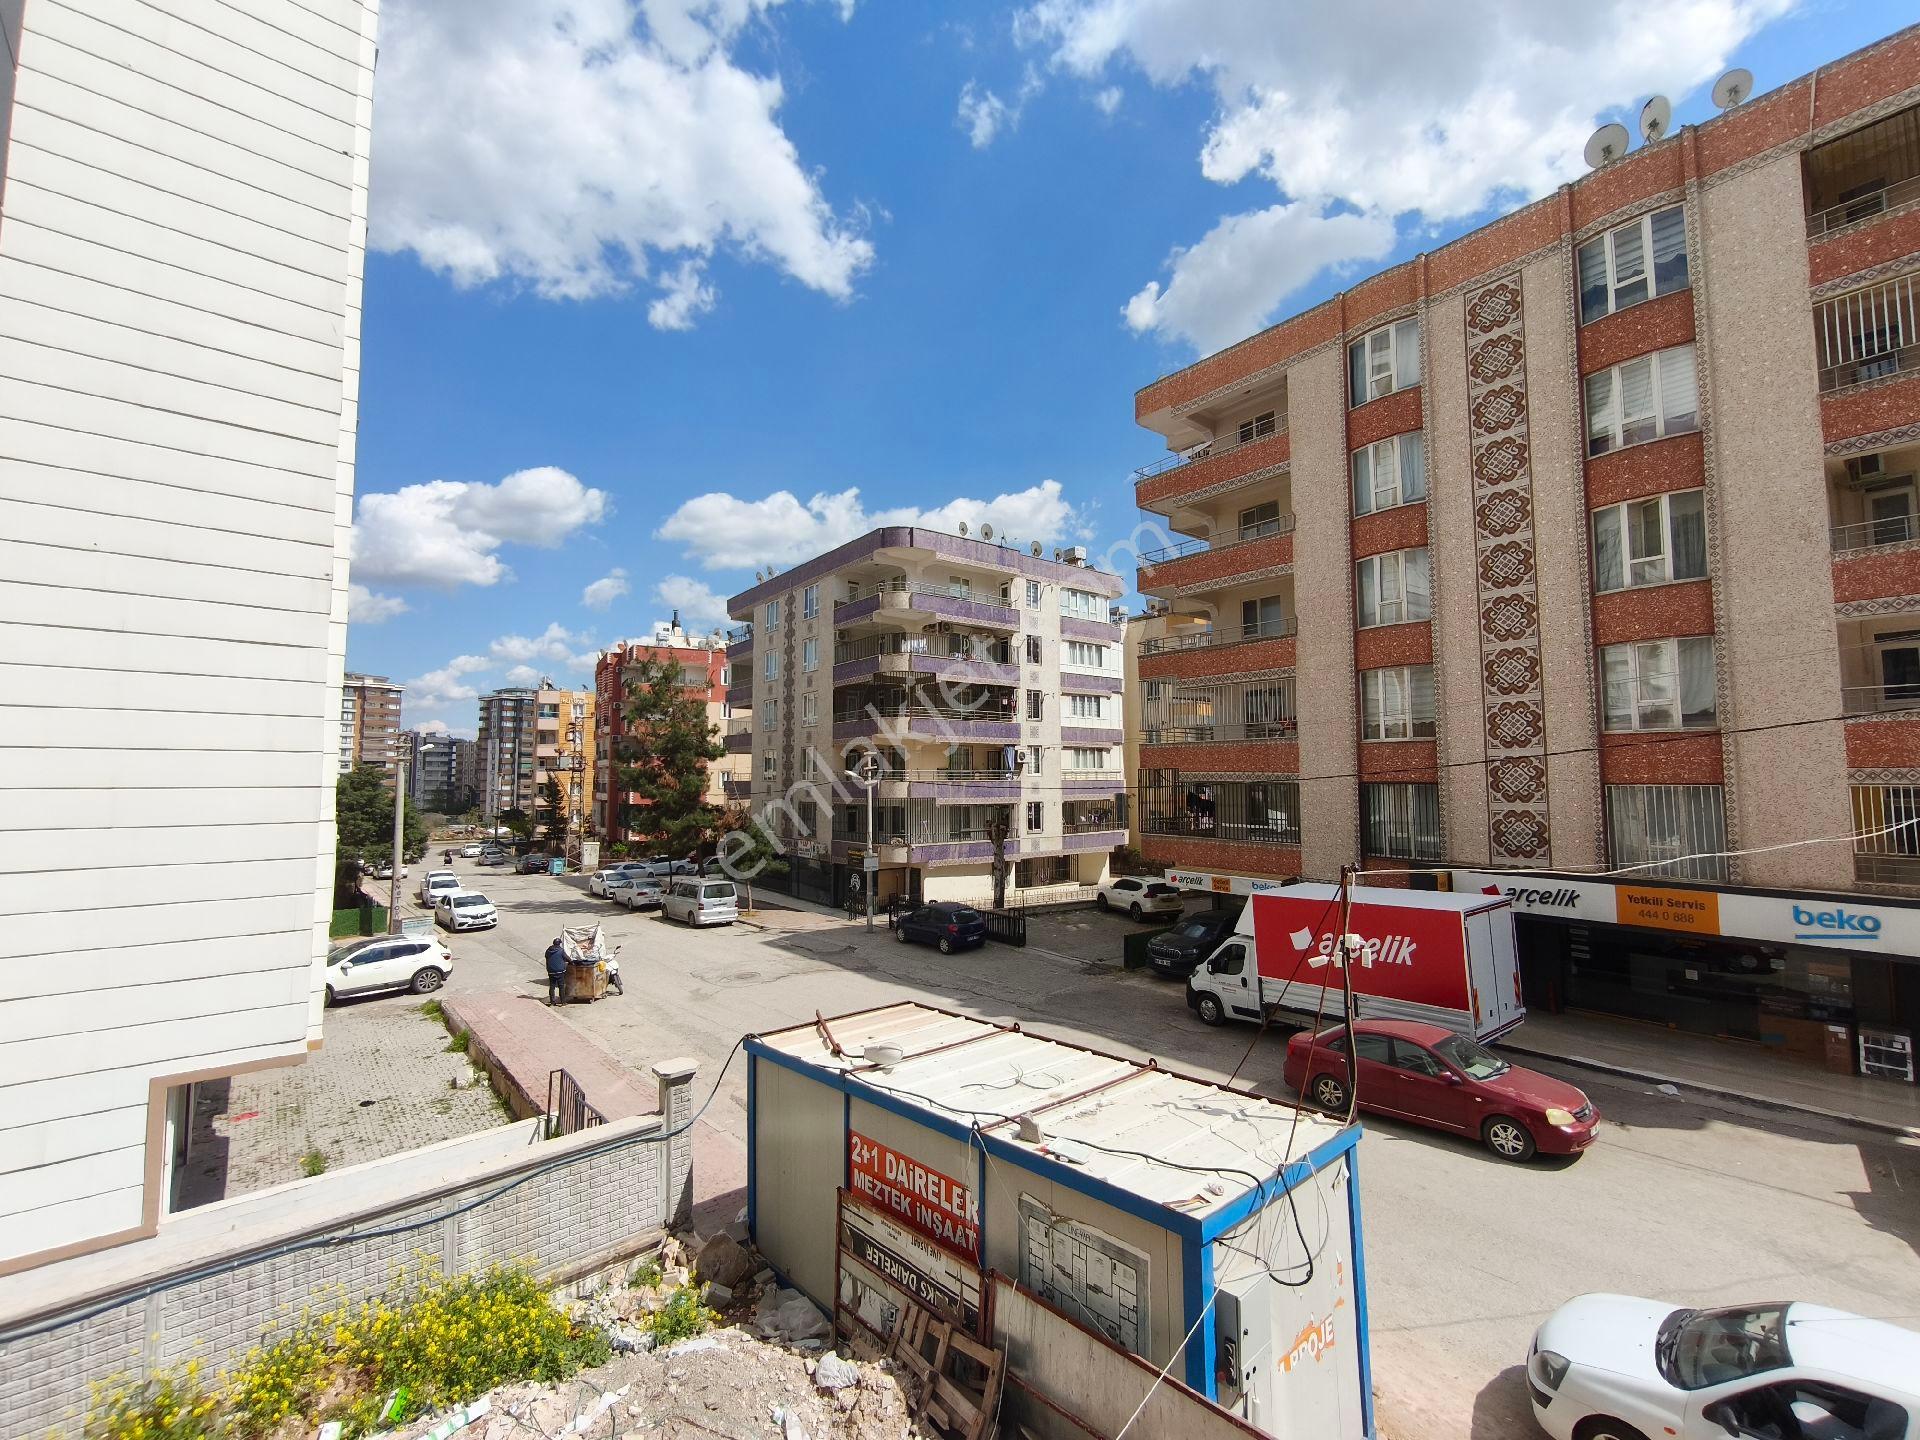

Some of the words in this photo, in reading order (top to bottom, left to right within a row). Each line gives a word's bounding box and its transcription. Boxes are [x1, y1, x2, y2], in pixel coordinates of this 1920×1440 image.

[1178, 873, 1204, 887] arçelik
[1504, 886, 1581, 908] arçelik
[1626, 894, 1664, 908] Yetkili
[1666, 898, 1706, 911] Servis
[1638, 909, 1659, 920] 444
[1662, 910, 1669, 921] 0
[1673, 912, 1695, 924] 888
[1792, 903, 1882, 933] beko
[851, 1135, 878, 1173] 2+1
[854, 1167, 912, 1217] MEZTEK
